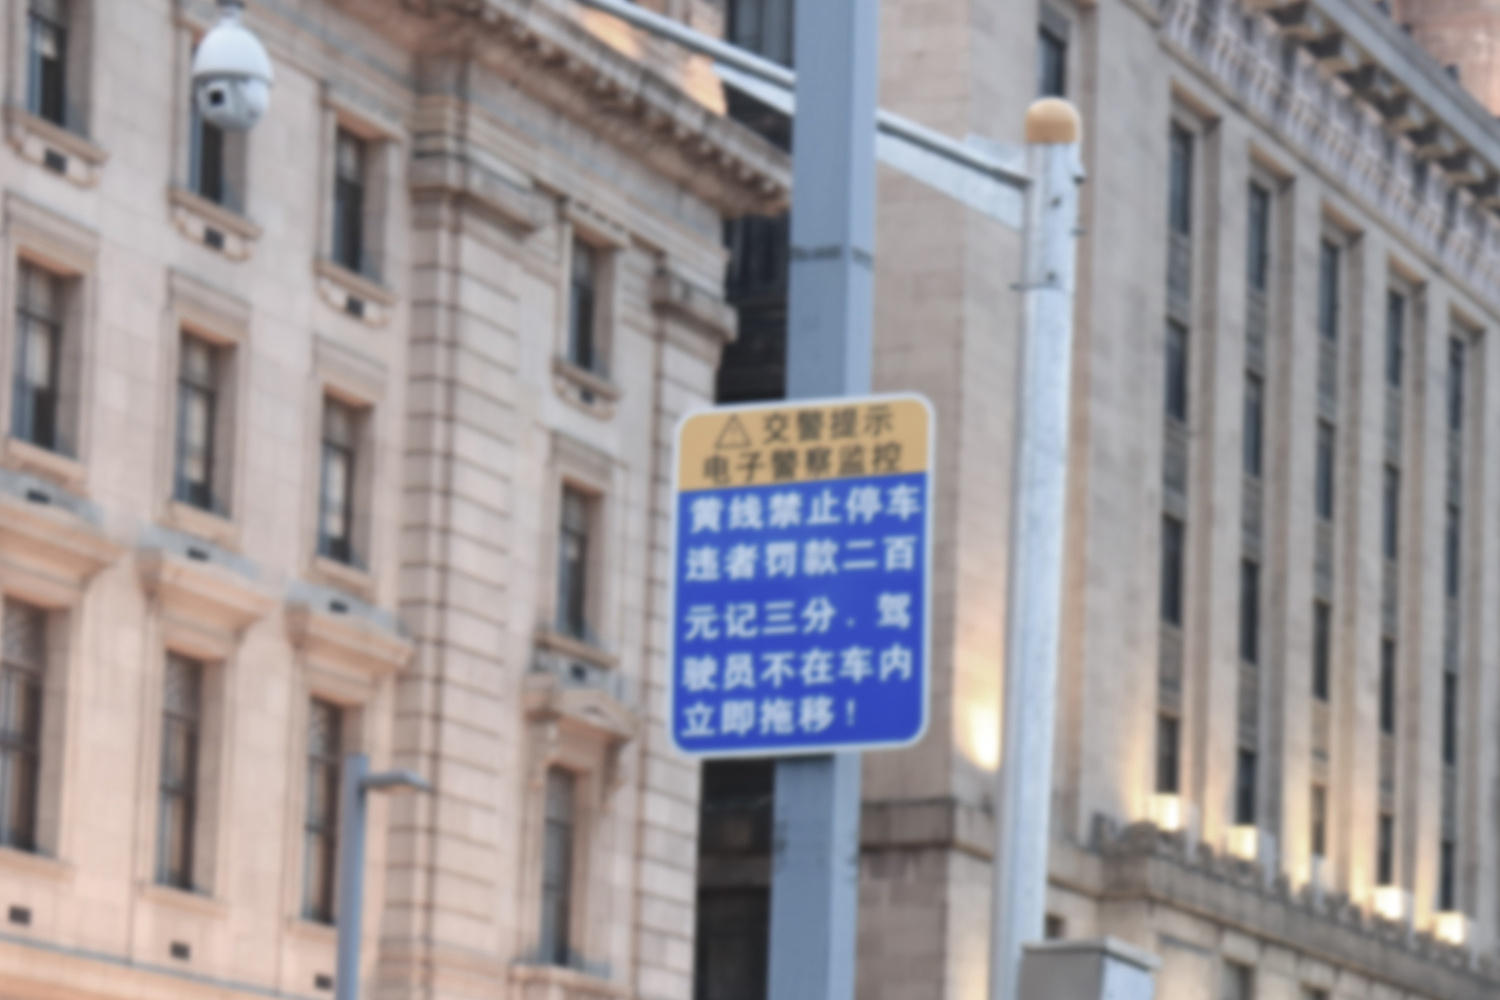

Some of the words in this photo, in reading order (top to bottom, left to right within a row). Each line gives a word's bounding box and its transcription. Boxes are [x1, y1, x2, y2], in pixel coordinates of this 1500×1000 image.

[690, 484, 921, 534] 黄线禁止停车
[685, 536, 916, 582] 违者罚款二百
